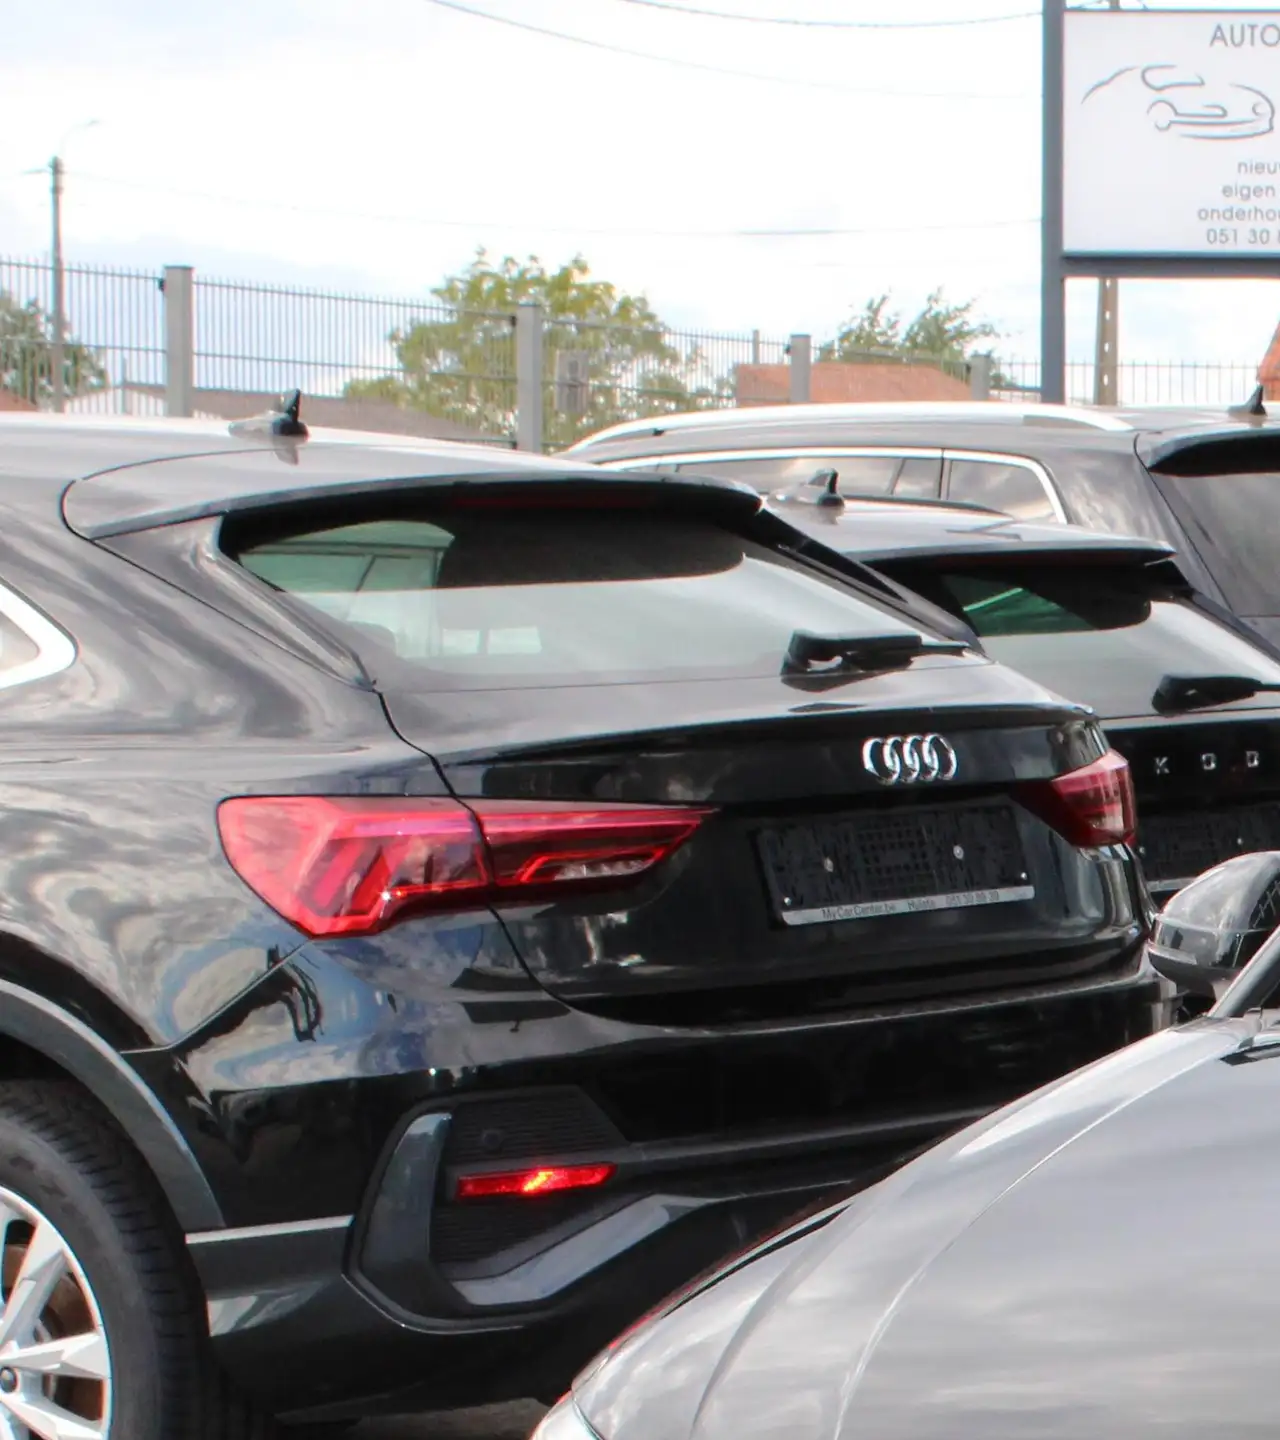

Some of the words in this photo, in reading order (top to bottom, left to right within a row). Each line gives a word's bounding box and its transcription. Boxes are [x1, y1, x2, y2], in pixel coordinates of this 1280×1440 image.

[1221, 183, 1276, 202] eigen
[1206, 228, 1238, 245] 051
[1248, 228, 1271, 245] 30
